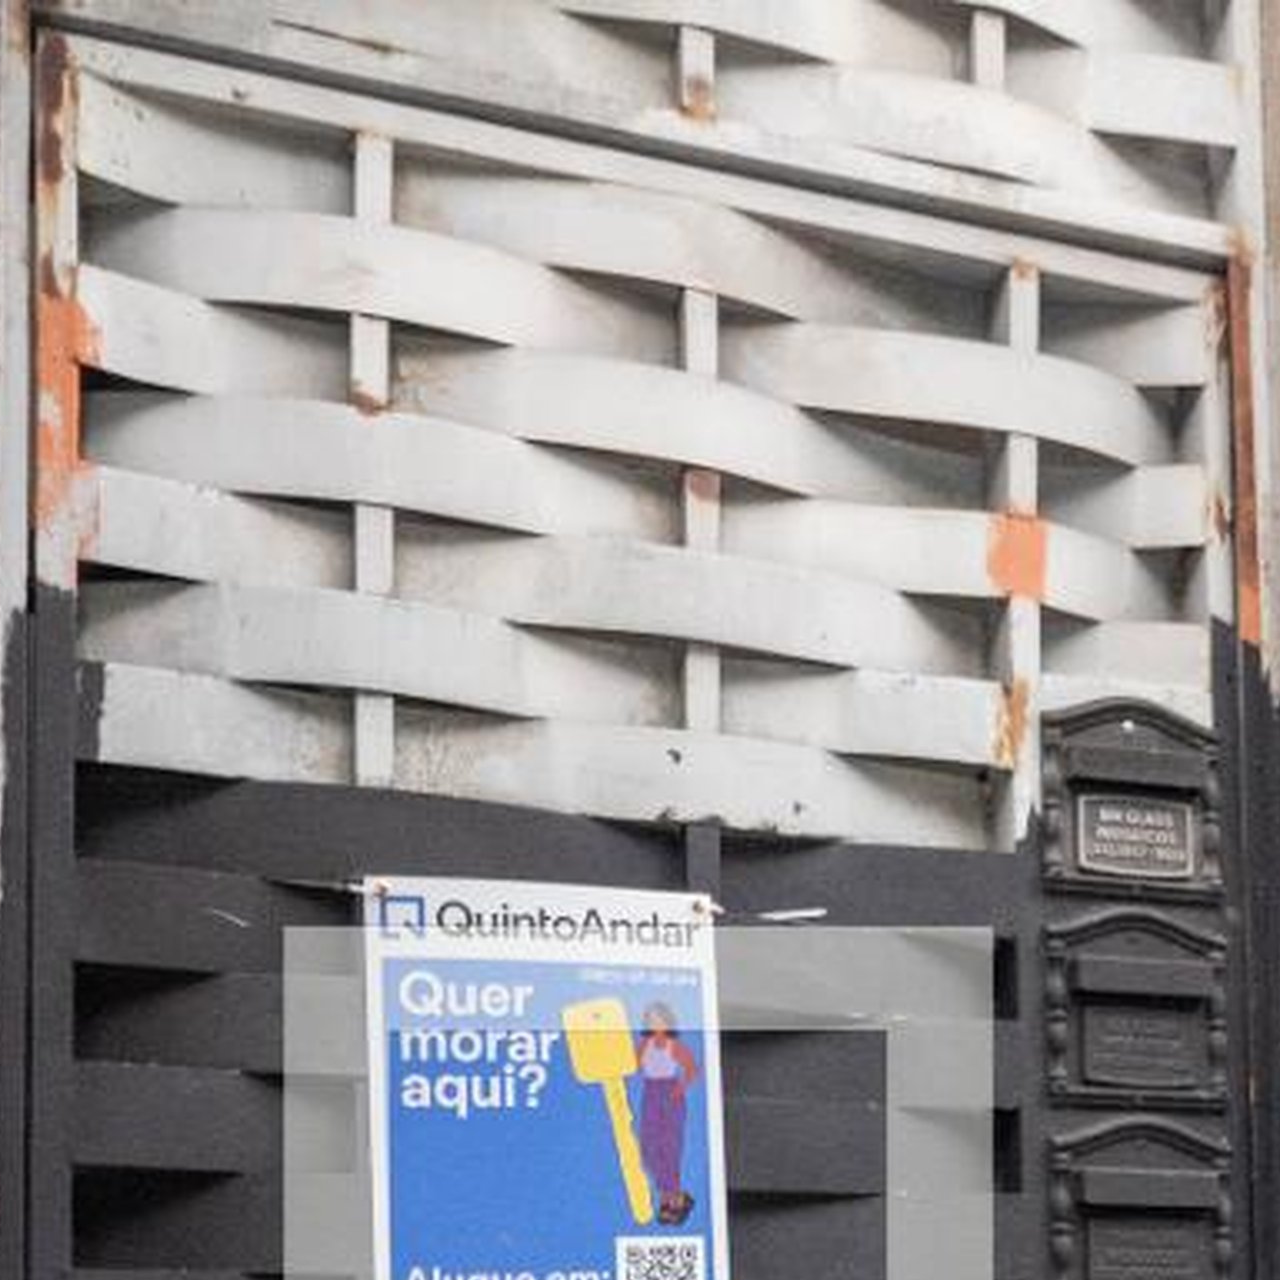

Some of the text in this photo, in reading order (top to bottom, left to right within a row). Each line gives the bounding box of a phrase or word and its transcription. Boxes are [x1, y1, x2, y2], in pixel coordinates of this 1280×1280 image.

[436, 901, 696, 948] QuintoAndar
[399, 970, 533, 1019] Quer
[399, 1027, 559, 1062] morar
[401, 1064, 547, 1118] aqui?
